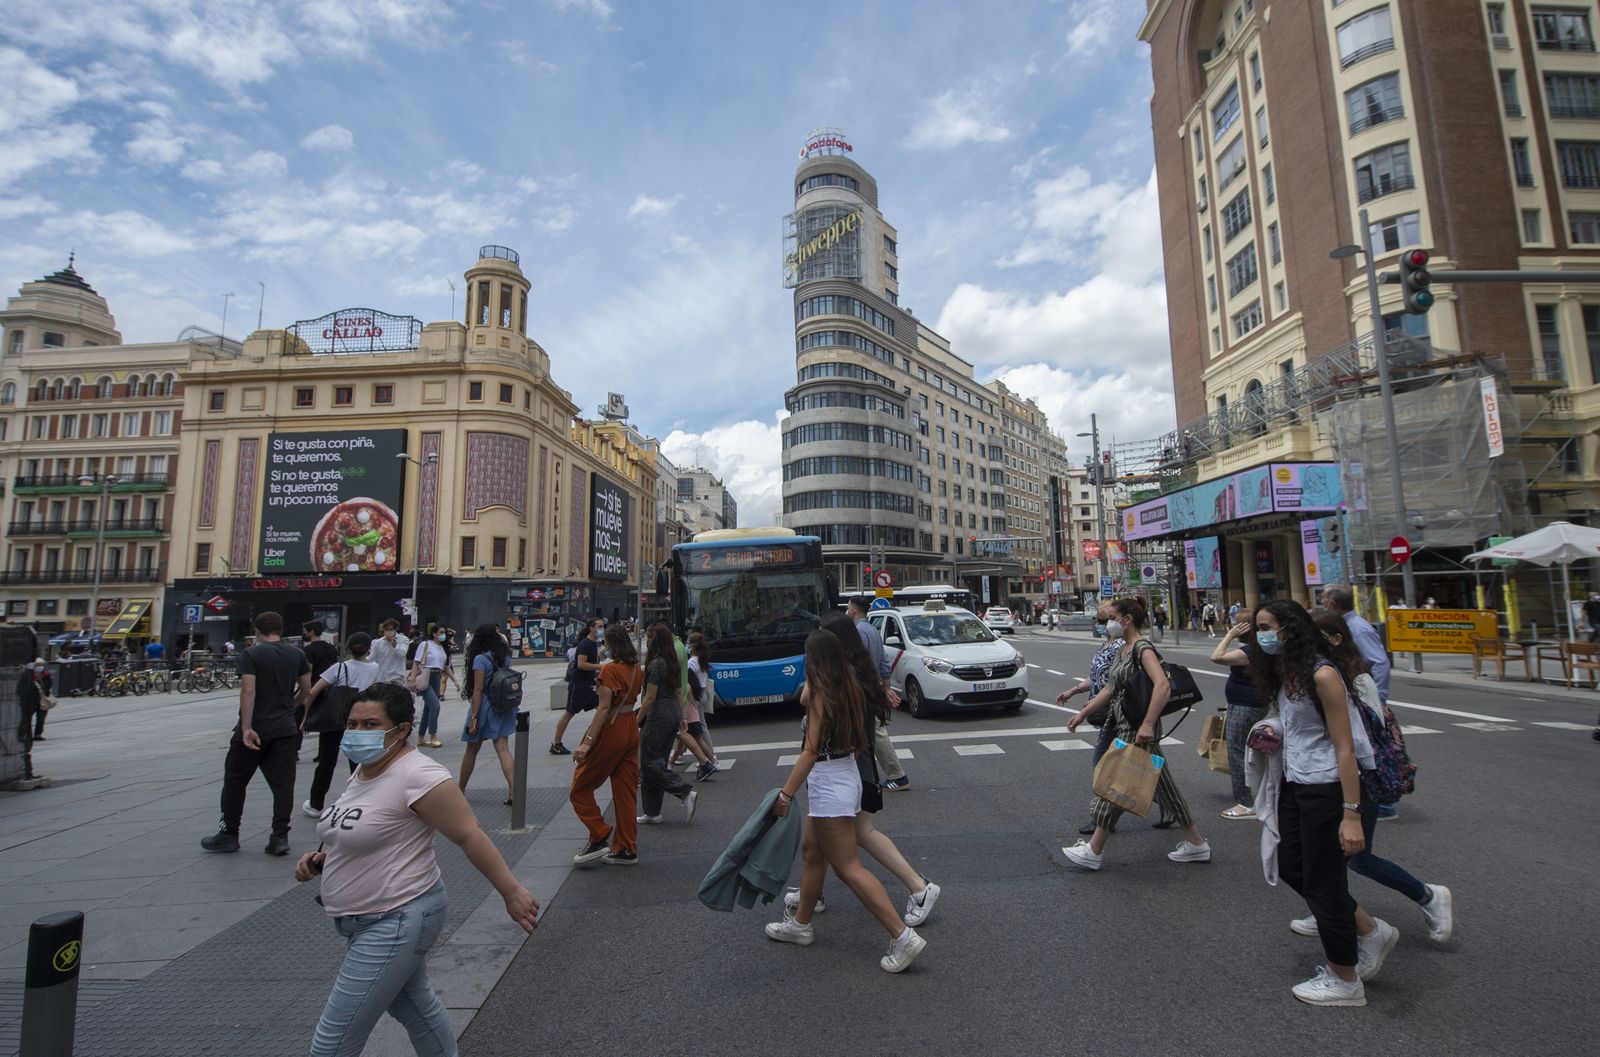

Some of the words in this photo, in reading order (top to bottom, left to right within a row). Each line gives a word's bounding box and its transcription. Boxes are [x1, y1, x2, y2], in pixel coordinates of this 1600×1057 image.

[807, 137, 853, 152] vodafone
[335, 317, 372, 327] CINES
[323, 326, 383, 339] CALLAO
[273, 439, 283, 450] Si
[285, 440, 295, 450] te
[297, 438, 326, 452] gusta
[328, 440, 348, 449] con
[350, 436, 375, 450] piña,
[272, 453, 283, 463] te
[285, 452, 342, 465] queremos.
[271, 470, 281, 481] Si
[282, 471, 296, 480] no
[298, 470, 308, 480] te
[311, 469, 343, 482] gusta,
[270, 483, 281, 493] te
[283, 482, 338, 495] queremos
[269, 496, 283, 506] un
[284, 495, 313, 507] poco
[315, 493, 340, 504] más.
[615, 491, 622, 514] te
[552, 462, 560, 566] CALLAO
[596, 507, 622, 533] mueve
[595, 529, 610, 550] nos
[264, 548, 286, 557] Uber
[264, 558, 285, 566] Eats
[594, 552, 621, 574] mueve
[702, 553, 712, 569] 2
[251, 578, 289, 590] CINES
[294, 577, 343, 589] CALLAO
[186, 607, 196, 620] P
[717, 670, 740, 680] 6848
